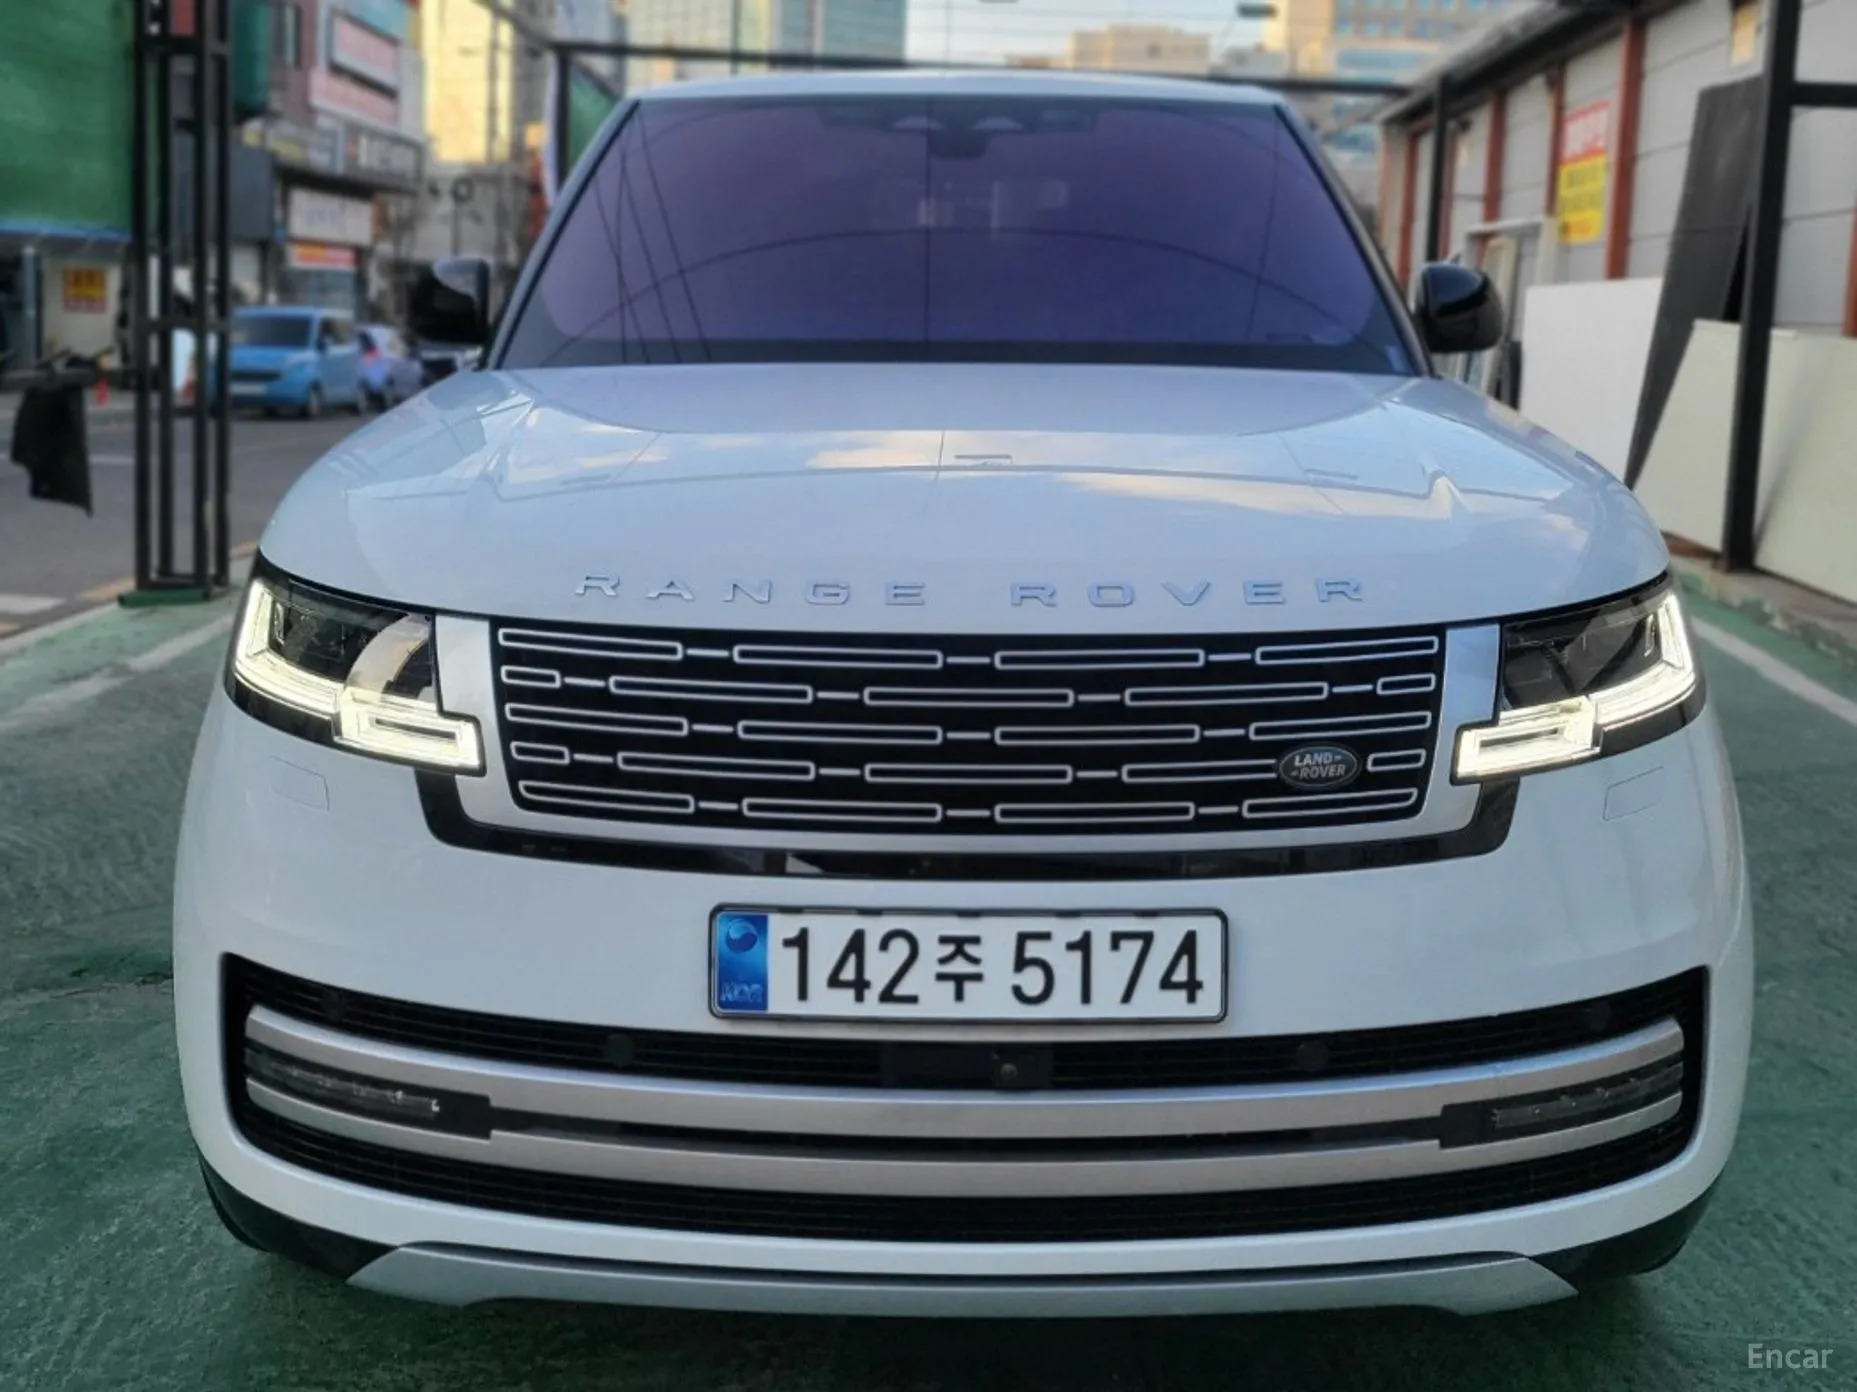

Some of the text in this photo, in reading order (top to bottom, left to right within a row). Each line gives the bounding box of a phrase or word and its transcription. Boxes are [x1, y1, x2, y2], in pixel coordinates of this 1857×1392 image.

[575, 574, 1364, 608] RANGE ROVER
[782, 926, 1204, 1005] 142주 5174
